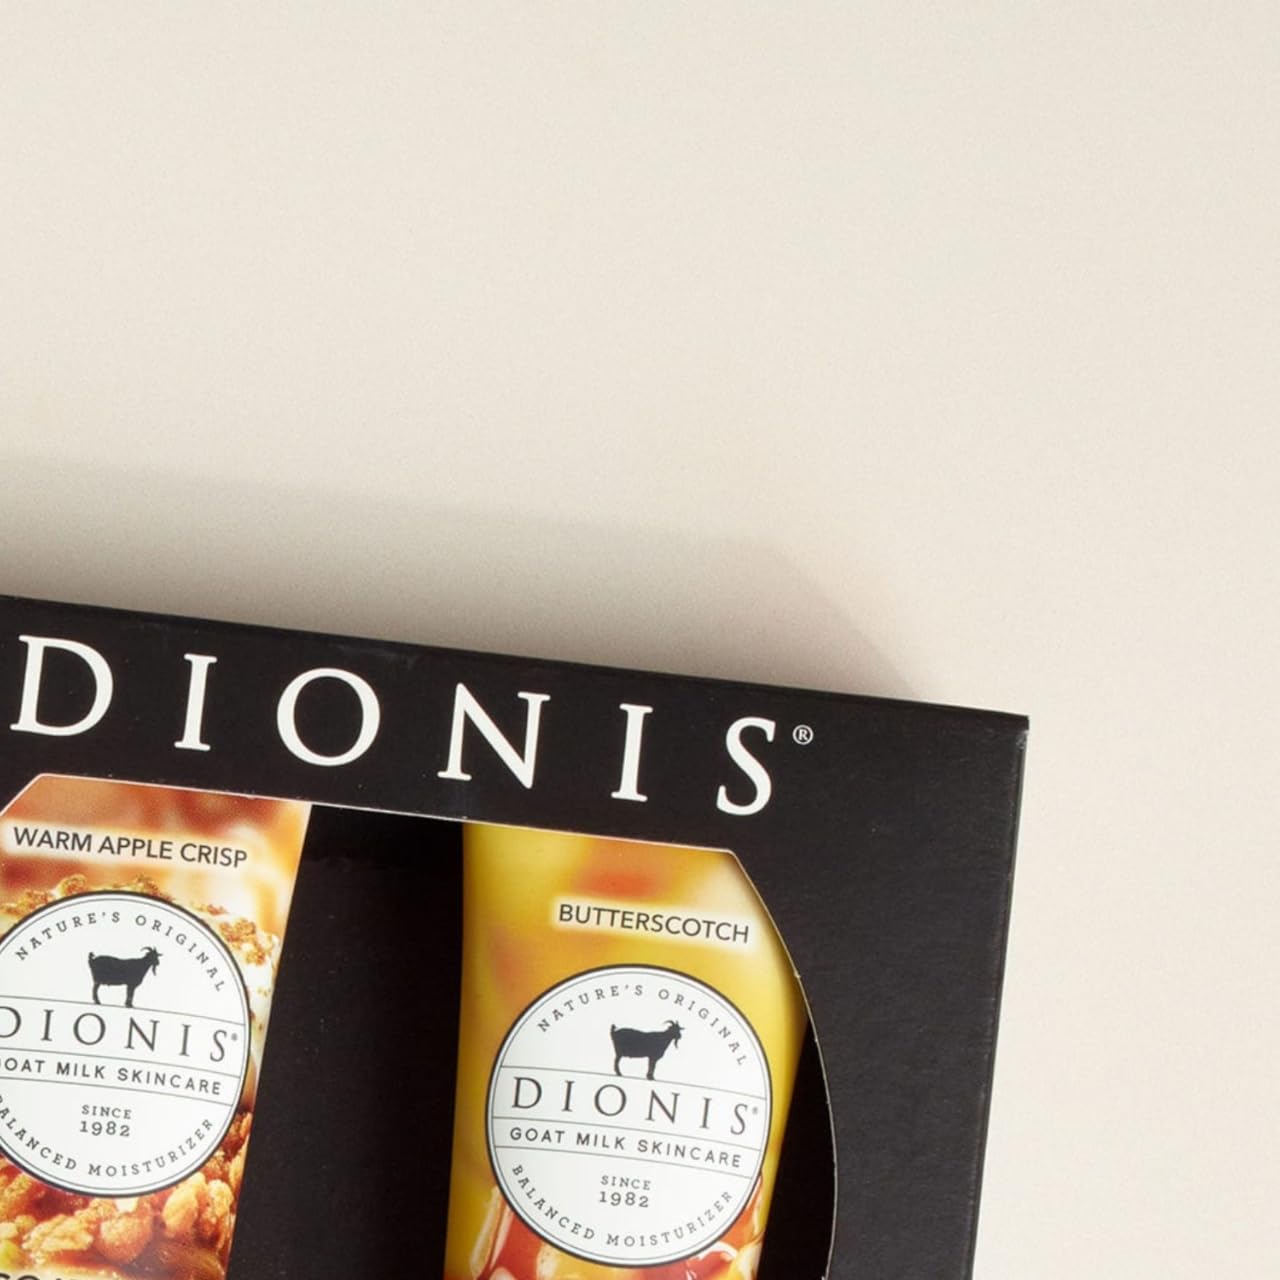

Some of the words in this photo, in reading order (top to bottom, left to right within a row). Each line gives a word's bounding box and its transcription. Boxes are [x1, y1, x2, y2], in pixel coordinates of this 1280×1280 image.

[13, 826, 93, 853] WARM
[98, 836, 174, 861] APPLE
[180, 843, 248, 868] CRISP
[558, 903, 750, 943] BUTTERSCOTCH
[14, 911, 121, 962] NATURE'S
[135, 914, 227, 993] ORIGINAL
[537, 984, 644, 1033] NATURE'S
[658, 988, 749, 1066] ORIGINAL
[55, 1061, 106, 1080] MILK
[117, 1067, 222, 1096] SKINCARE
[78, 1120, 132, 1138] 1982
[80, 1104, 133, 1120] SINCE
[88, 1117, 214, 1177] MOISTURIZER
[509, 1126, 566, 1144] GOAT
[576, 1132, 626, 1150] MILK
[637, 1139, 742, 1168] SKINCARE
[598, 1191, 650, 1208] 1982
[600, 1175, 652, 1190] SINCE
[511, 1164, 595, 1240] BALANCED
[606, 1190, 733, 1248] MOISTURIZER
